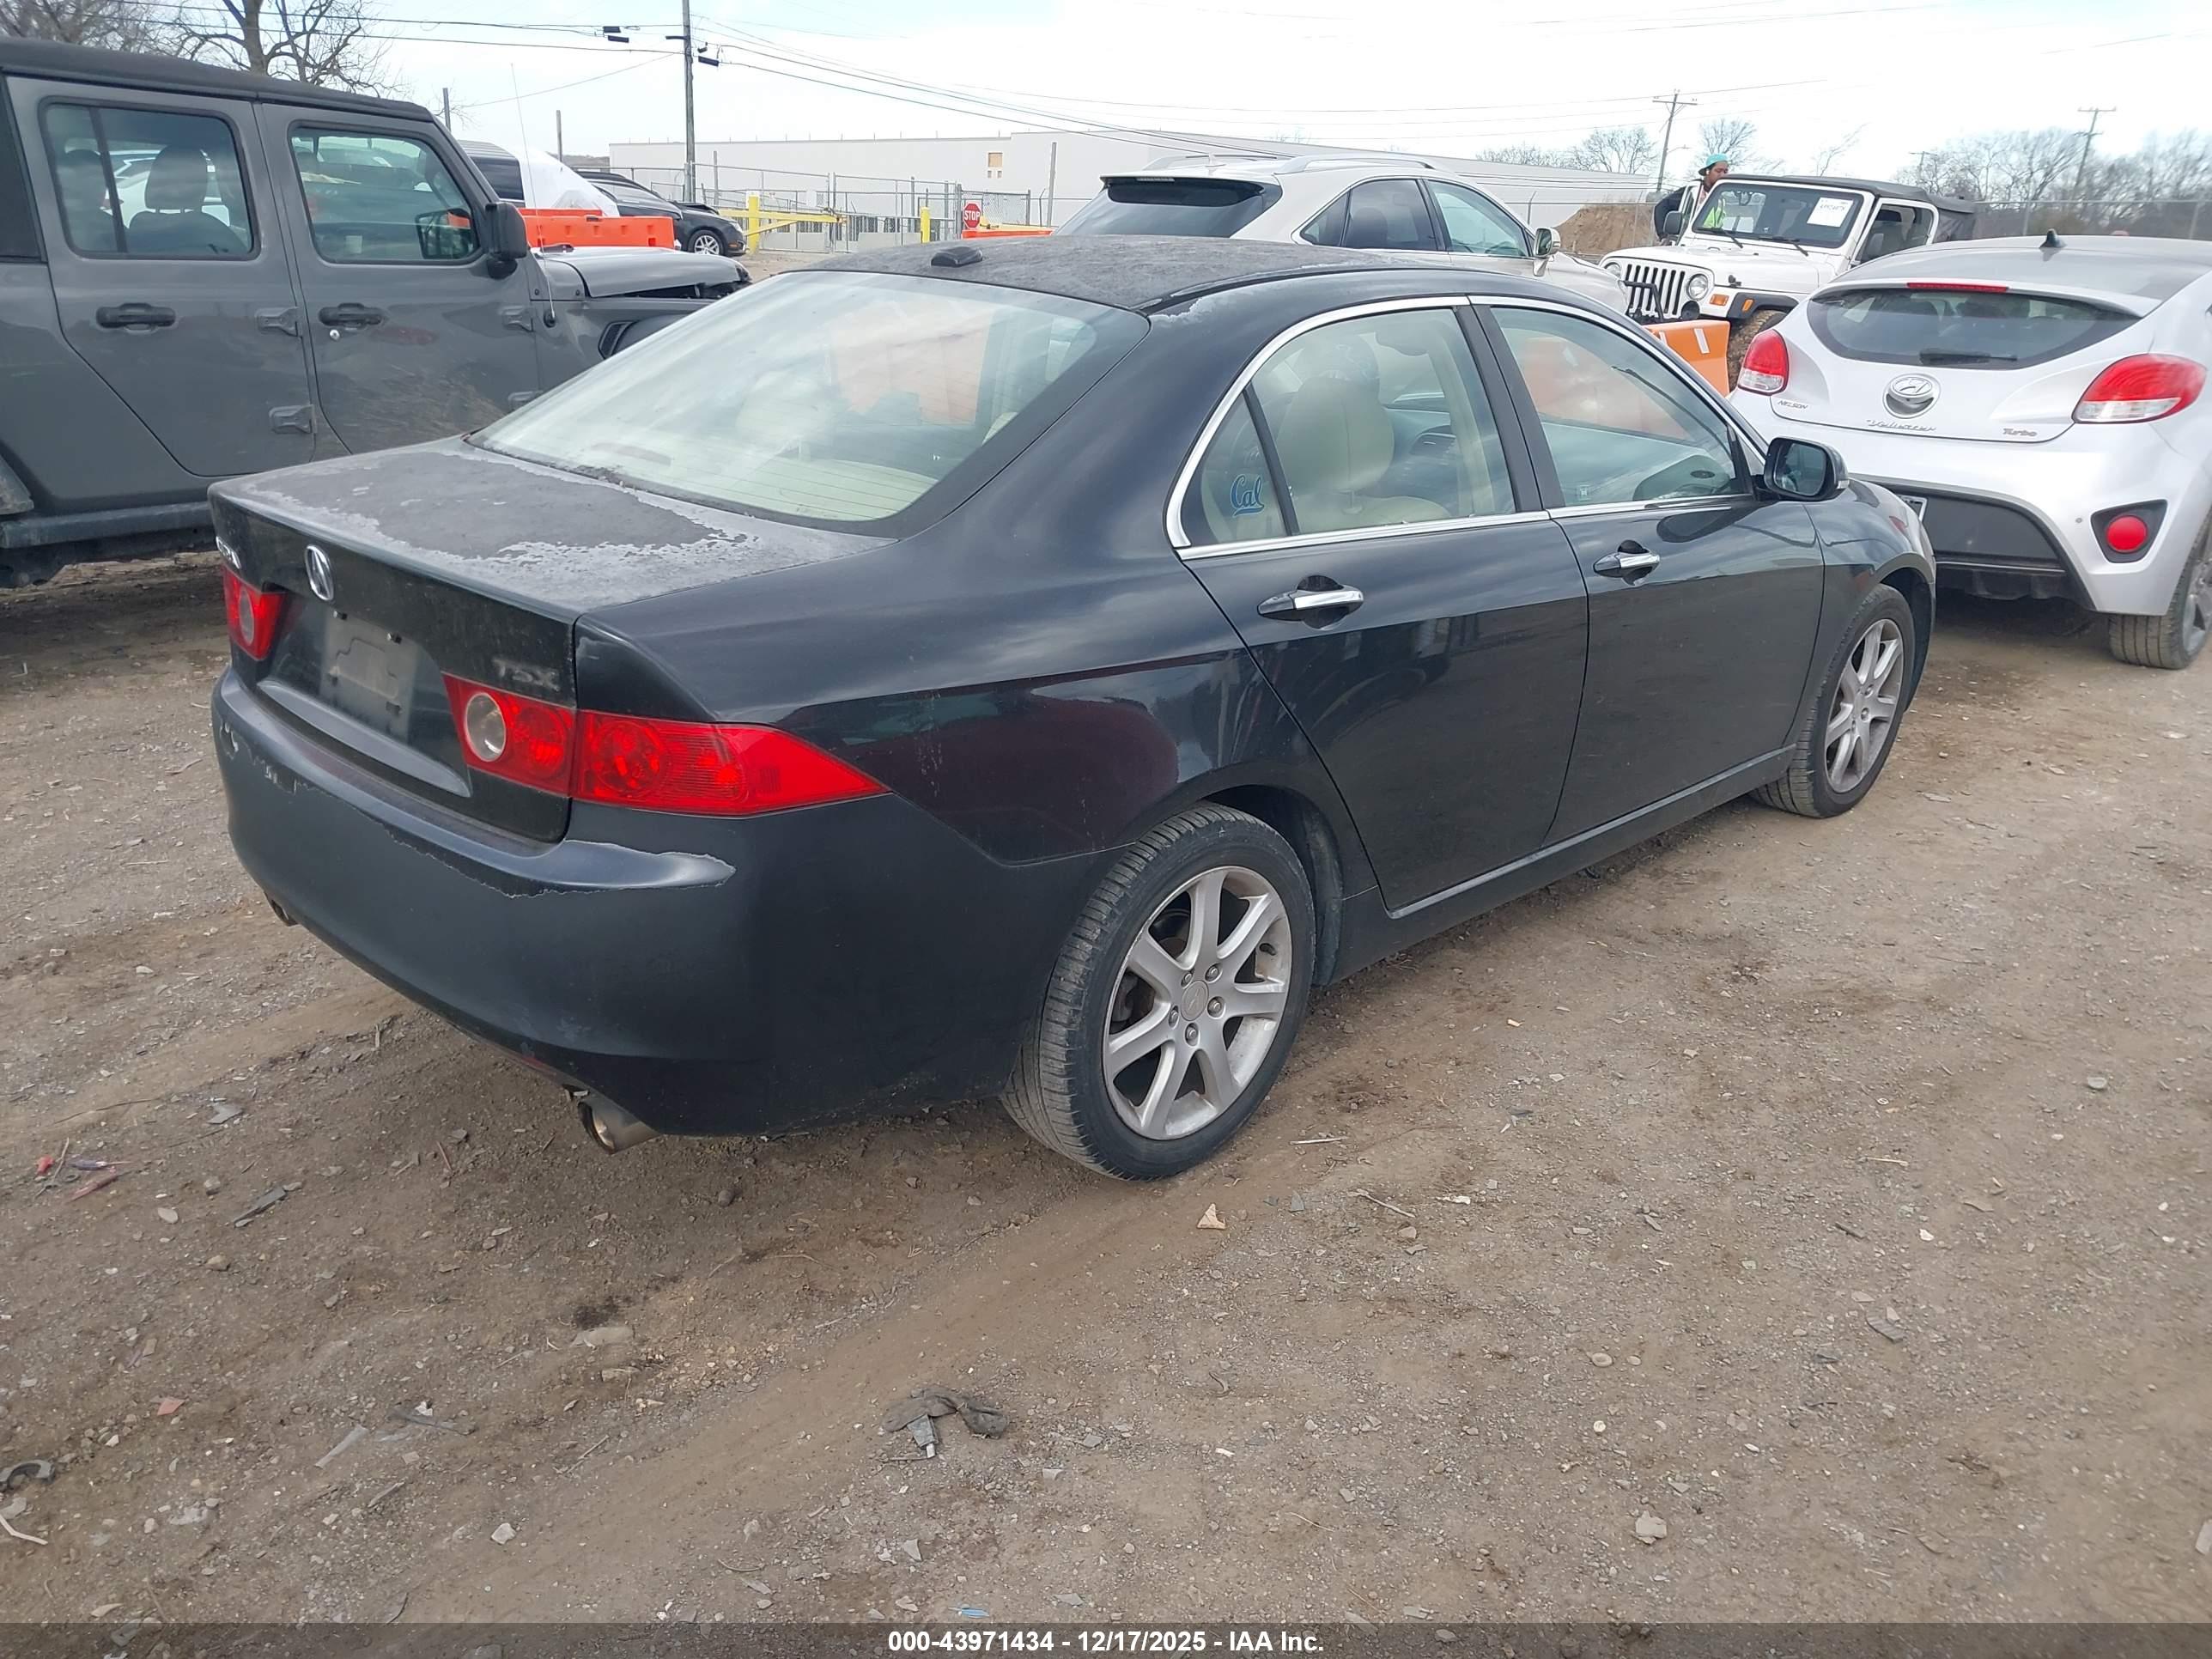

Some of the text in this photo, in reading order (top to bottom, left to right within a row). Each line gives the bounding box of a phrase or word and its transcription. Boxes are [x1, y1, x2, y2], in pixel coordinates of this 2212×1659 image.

[964, 210, 981, 221] STOP
[2002, 428, 2038, 437] Turbo
[1230, 473, 1265, 518] Cal
